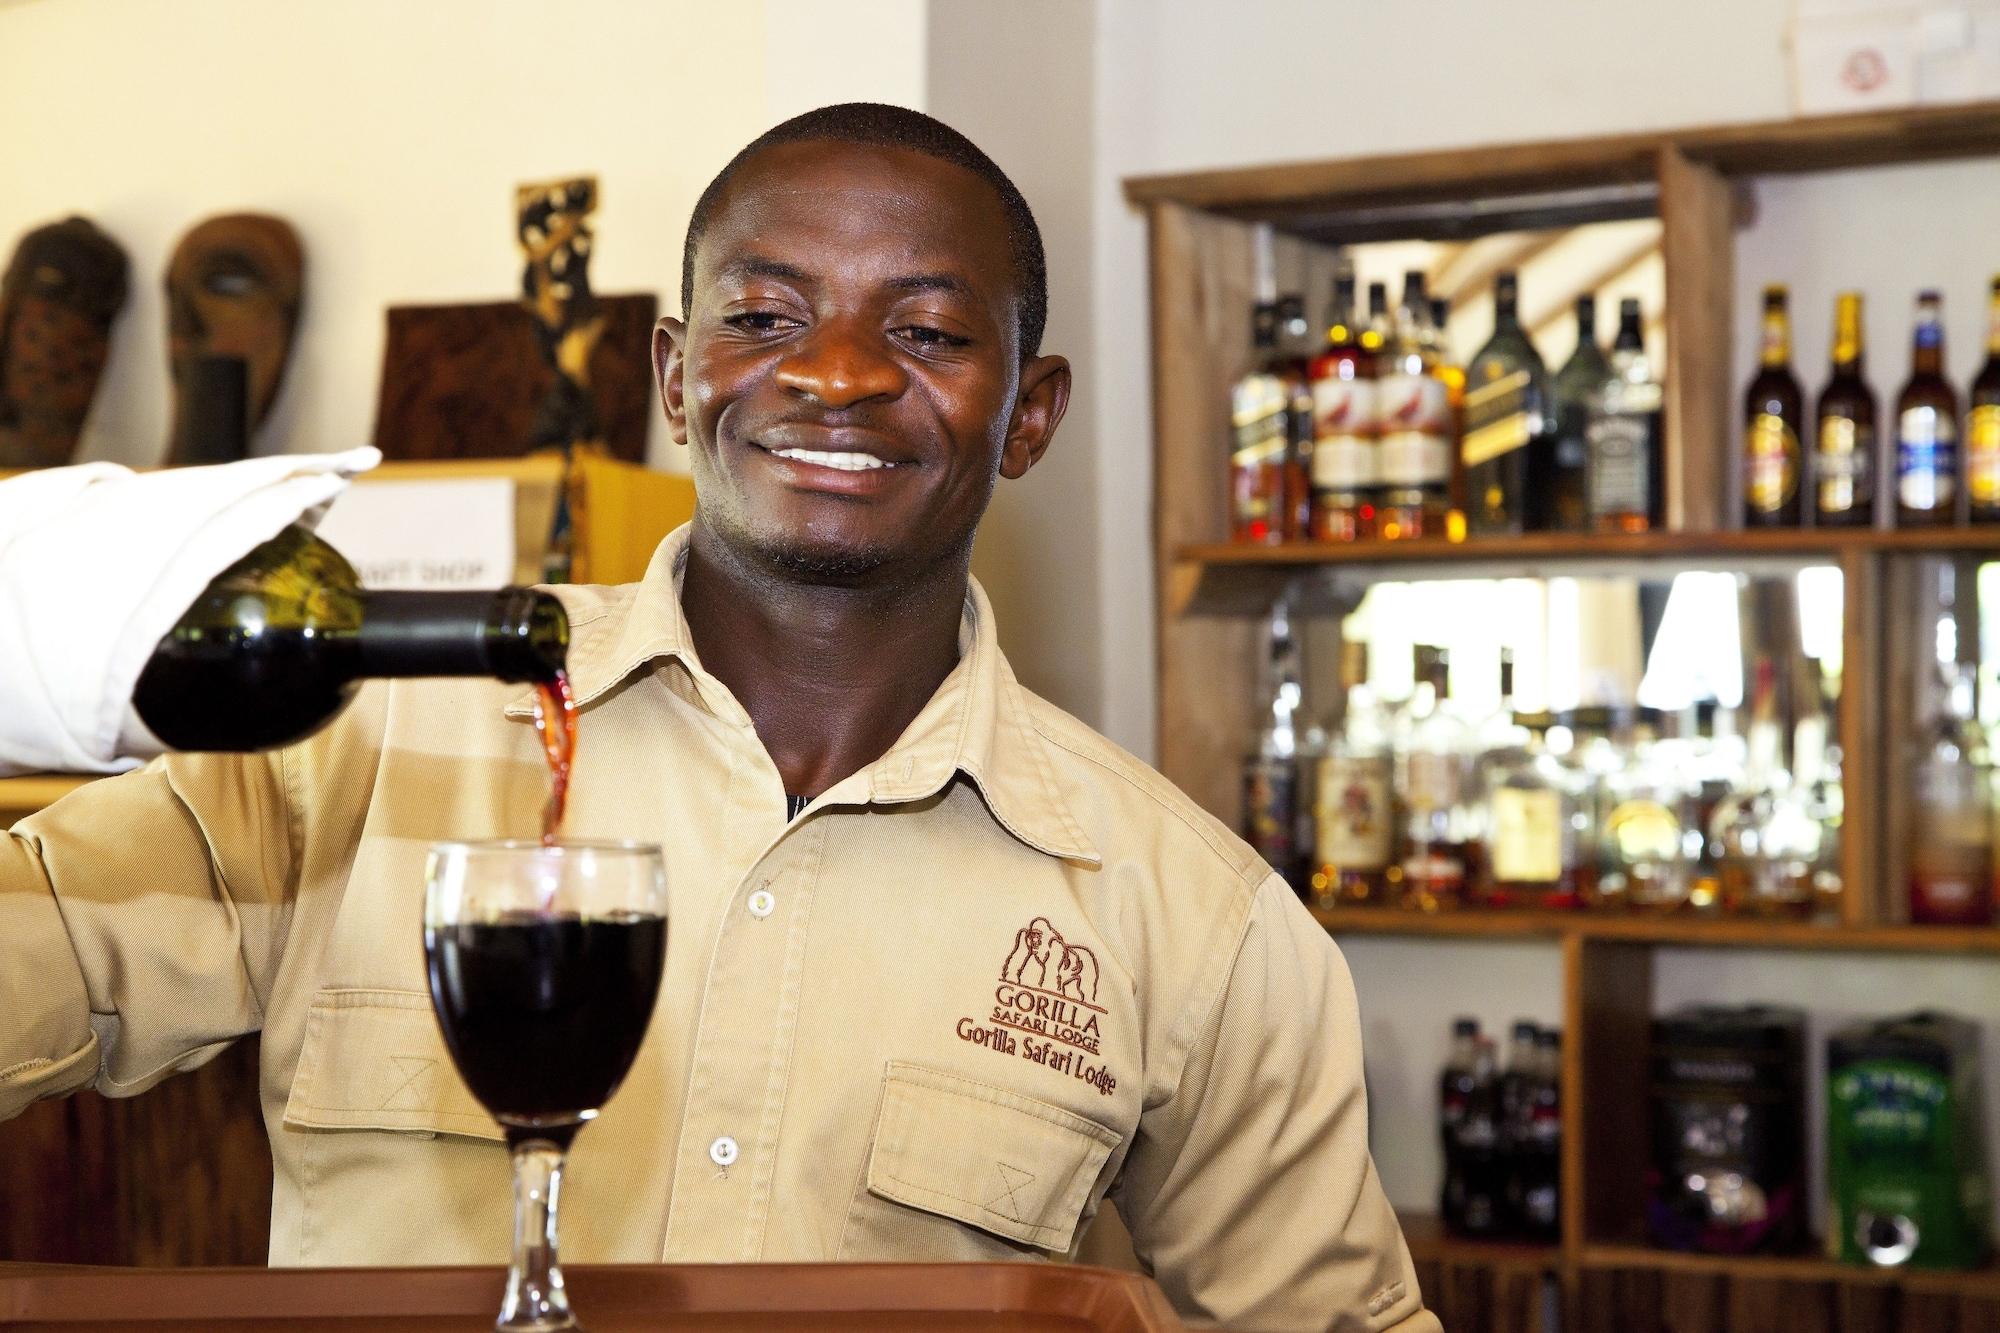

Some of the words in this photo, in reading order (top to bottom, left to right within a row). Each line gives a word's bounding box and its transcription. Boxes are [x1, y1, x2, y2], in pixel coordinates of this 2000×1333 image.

[992, 1006, 1047, 1034] SAFARI
[1053, 1024, 1101, 1050] LODGE
[995, 985, 1101, 1038] GORILLA
[956, 1017, 1017, 1056] Gorilla
[1022, 1037, 1072, 1075] Safari
[1074, 1054, 1117, 1096] Lodge
